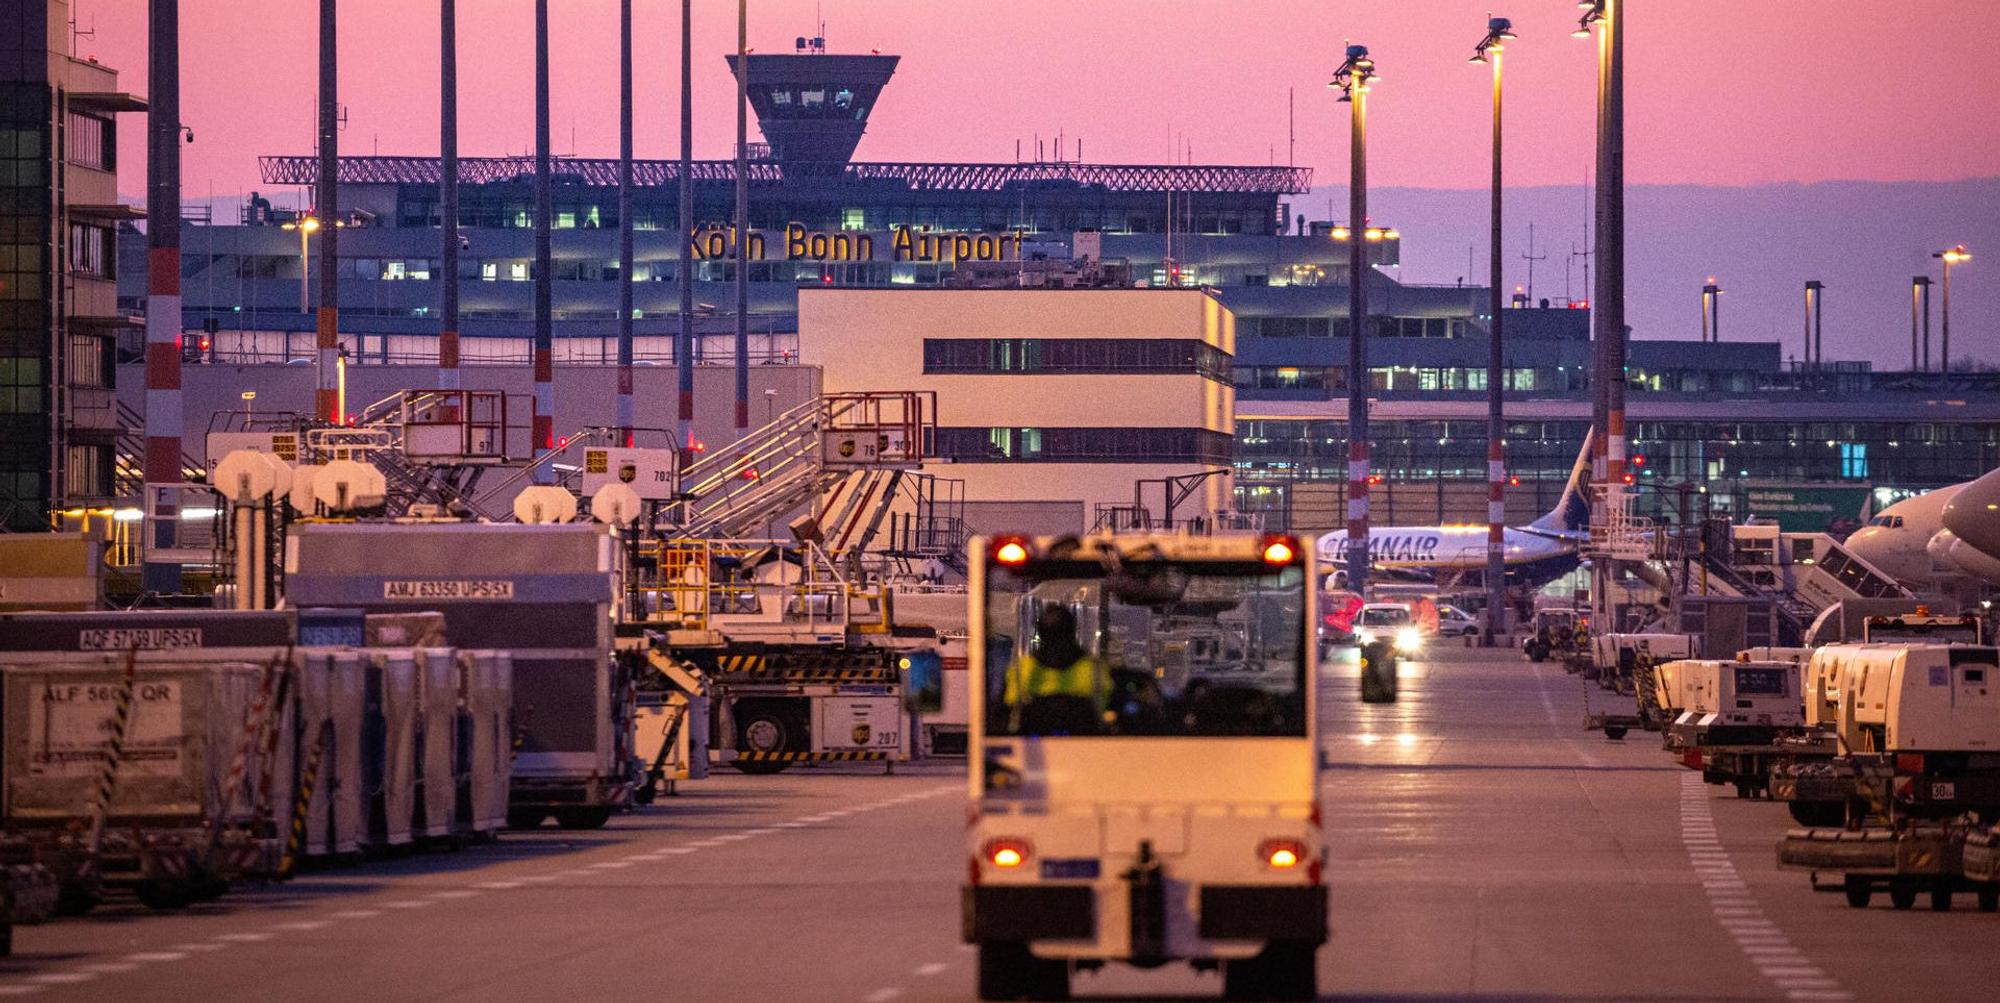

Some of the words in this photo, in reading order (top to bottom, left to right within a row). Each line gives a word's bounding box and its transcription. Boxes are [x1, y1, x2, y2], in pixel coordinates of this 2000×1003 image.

[690, 221, 766, 261] Köln
[785, 221, 873, 261] Bonn
[893, 223, 1024, 271] Airport
[479, 441, 490, 452] 97
[654, 470, 671, 482] 702
[387, 582, 417, 597] AMJ
